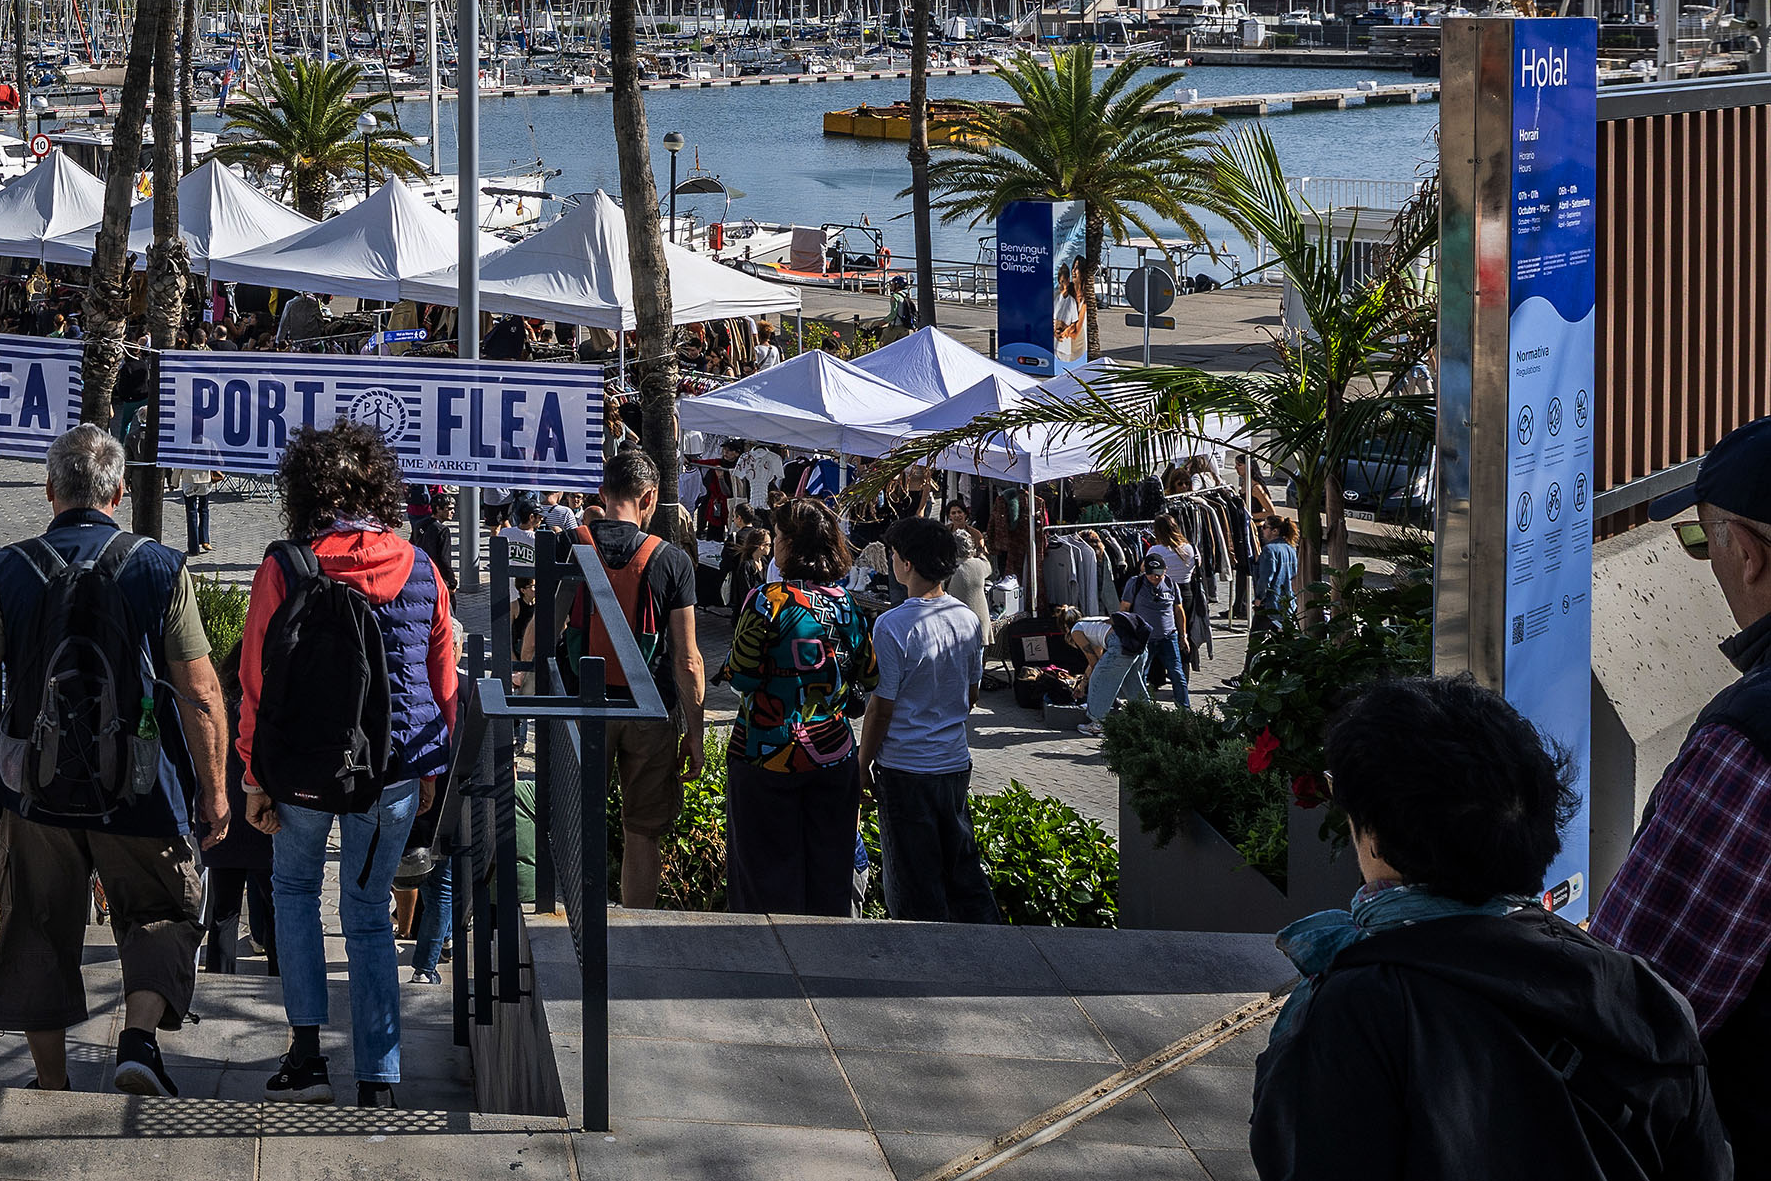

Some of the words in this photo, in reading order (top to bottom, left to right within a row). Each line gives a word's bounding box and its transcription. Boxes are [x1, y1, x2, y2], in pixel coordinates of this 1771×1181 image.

[1521, 47, 1568, 87] Hola!
[1519, 127, 1539, 141] Horari
[35, 141, 46, 150] 10
[1518, 205, 1536, 216] Octubre
[1000, 242, 1048, 256] Benvingut,
[1000, 253, 1018, 262] nou
[1020, 253, 1040, 264] Port
[1516, 345, 1550, 363] Normativa
[1516, 364, 1541, 378] Regulations
[364, 402, 370, 412] P
[386, 402, 393, 412] F
[191, 377, 325, 448] PORT
[436, 386, 569, 463] FLEA
[427, 459, 481, 472] MARKET
[1026, 642, 1042, 656] 1€
[280, 1074, 289, 1083] S
